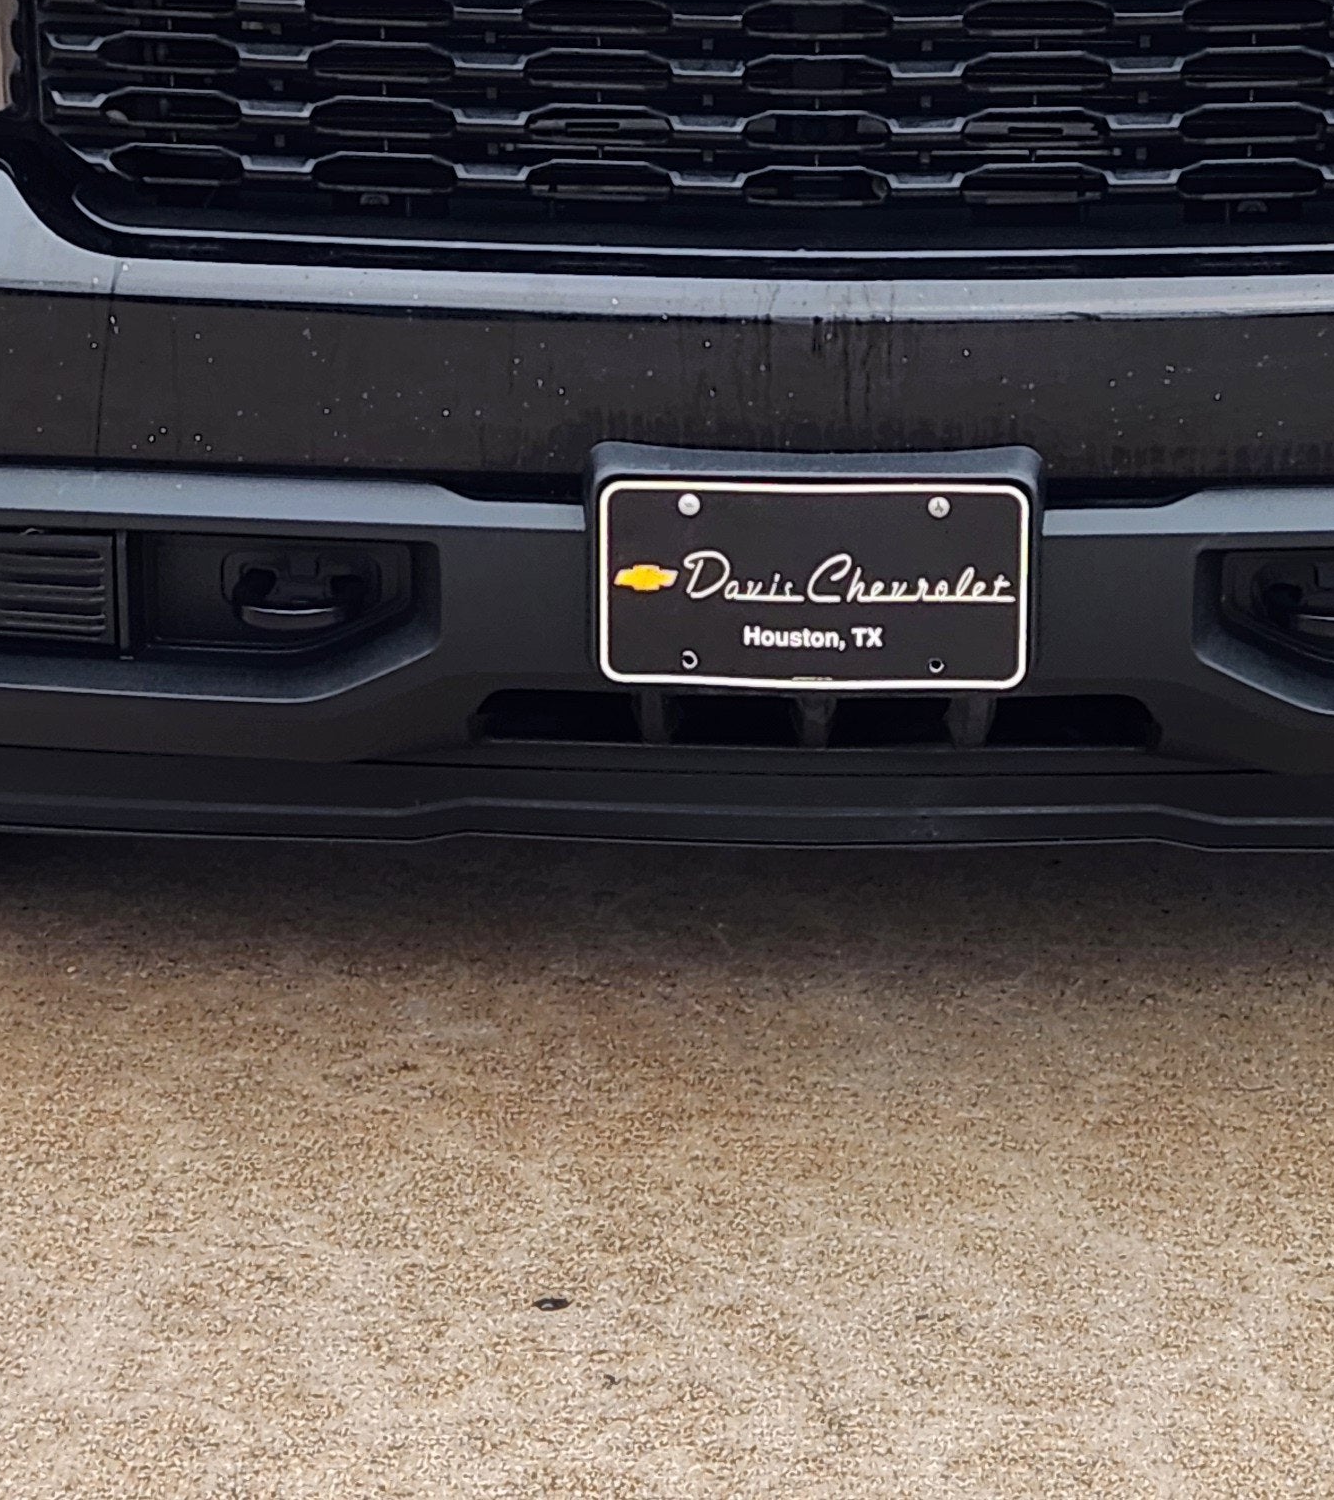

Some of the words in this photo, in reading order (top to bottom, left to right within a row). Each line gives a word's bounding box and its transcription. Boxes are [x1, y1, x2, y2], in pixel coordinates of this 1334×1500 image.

[683, 550, 805, 601] Davis
[806, 553, 1017, 603] Chevrolet
[742, 625, 846, 652] Houston,
[851, 627, 883, 648] TX
